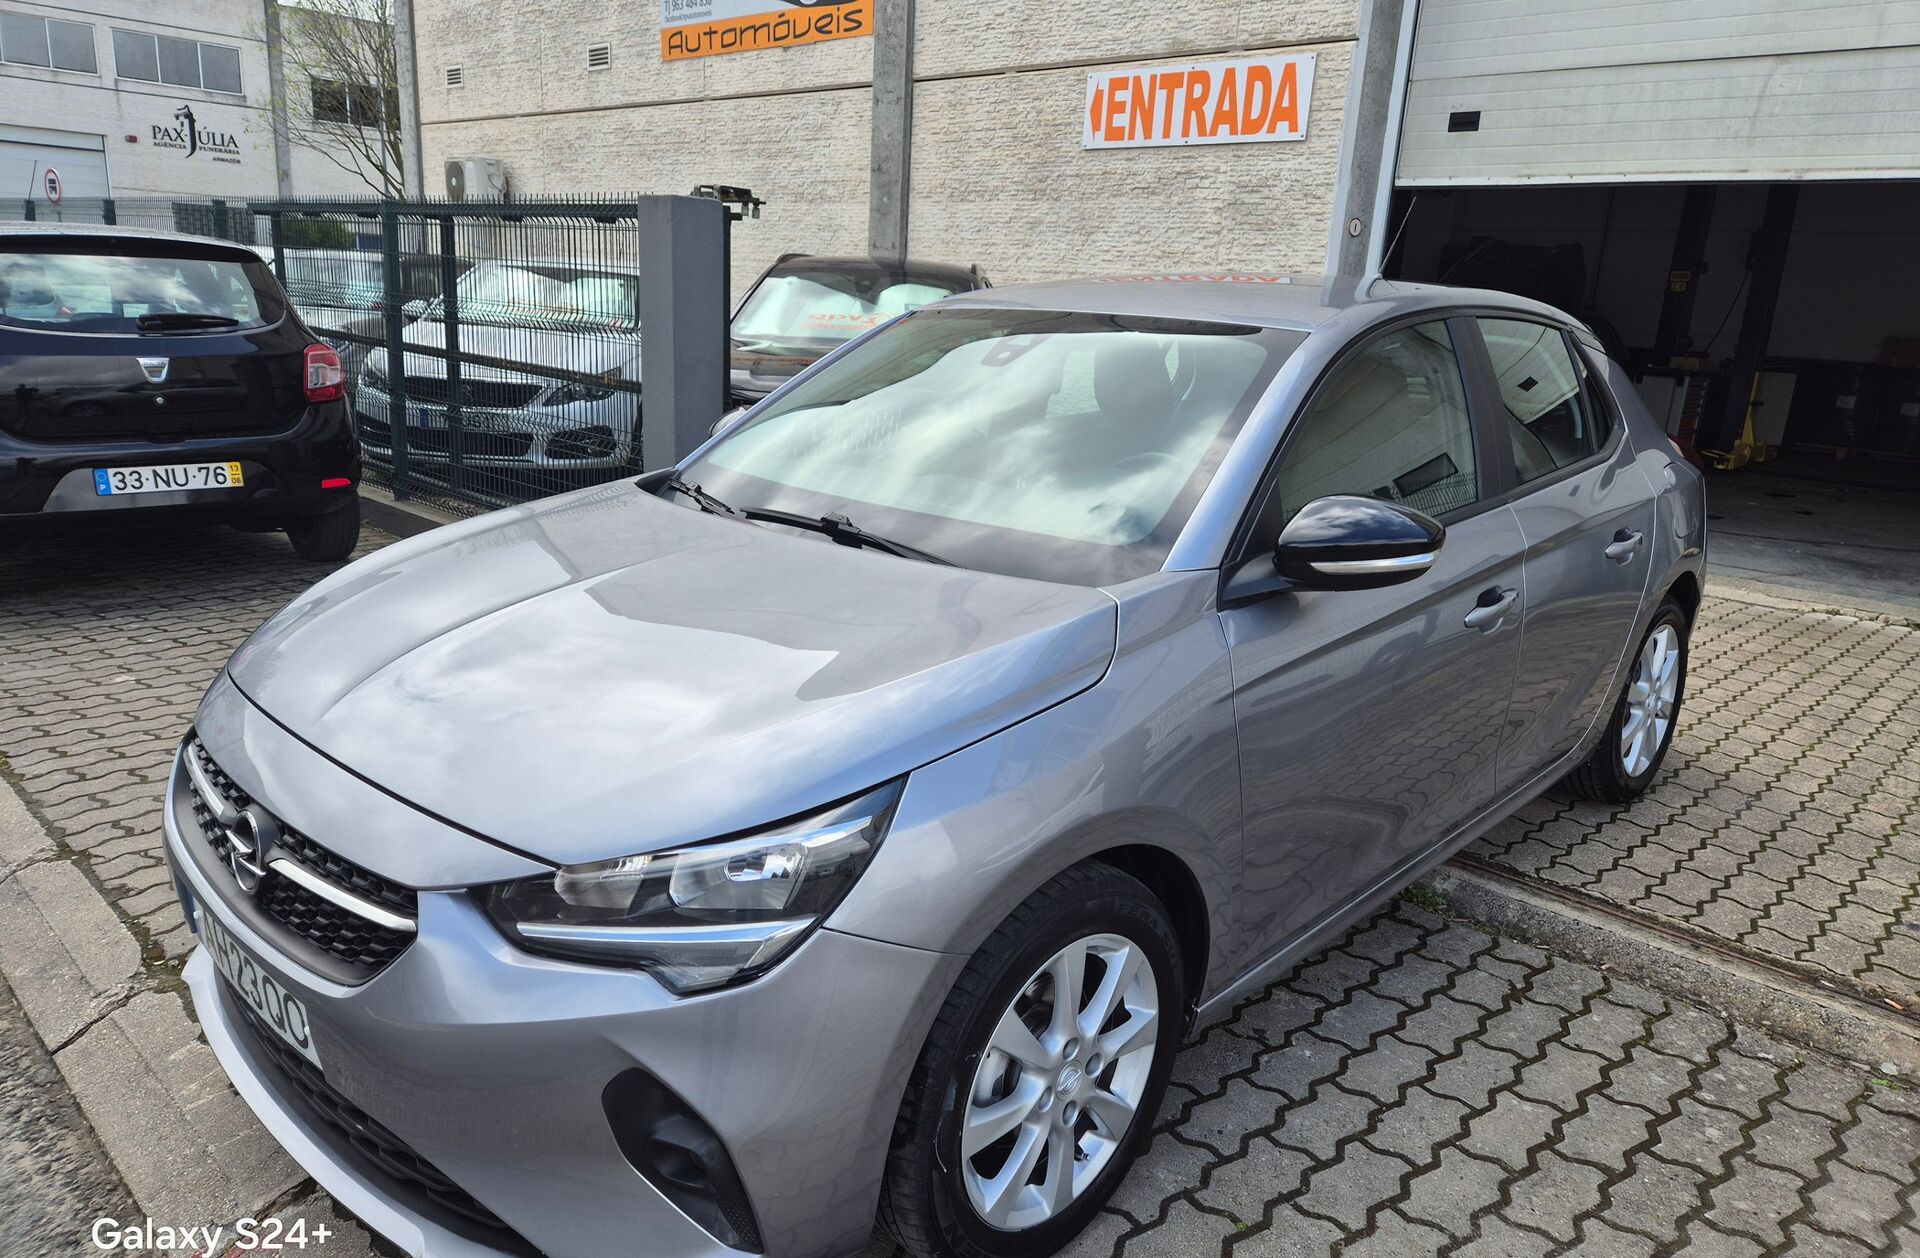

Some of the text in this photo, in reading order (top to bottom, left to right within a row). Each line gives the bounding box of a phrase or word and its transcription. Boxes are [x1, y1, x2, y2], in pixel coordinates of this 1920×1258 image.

[668, 6, 863, 55] Automóveis
[1104, 62, 1298, 141] ENTRADA
[153, 140, 240, 155] AGÊNCIA FUNERÁRIA
